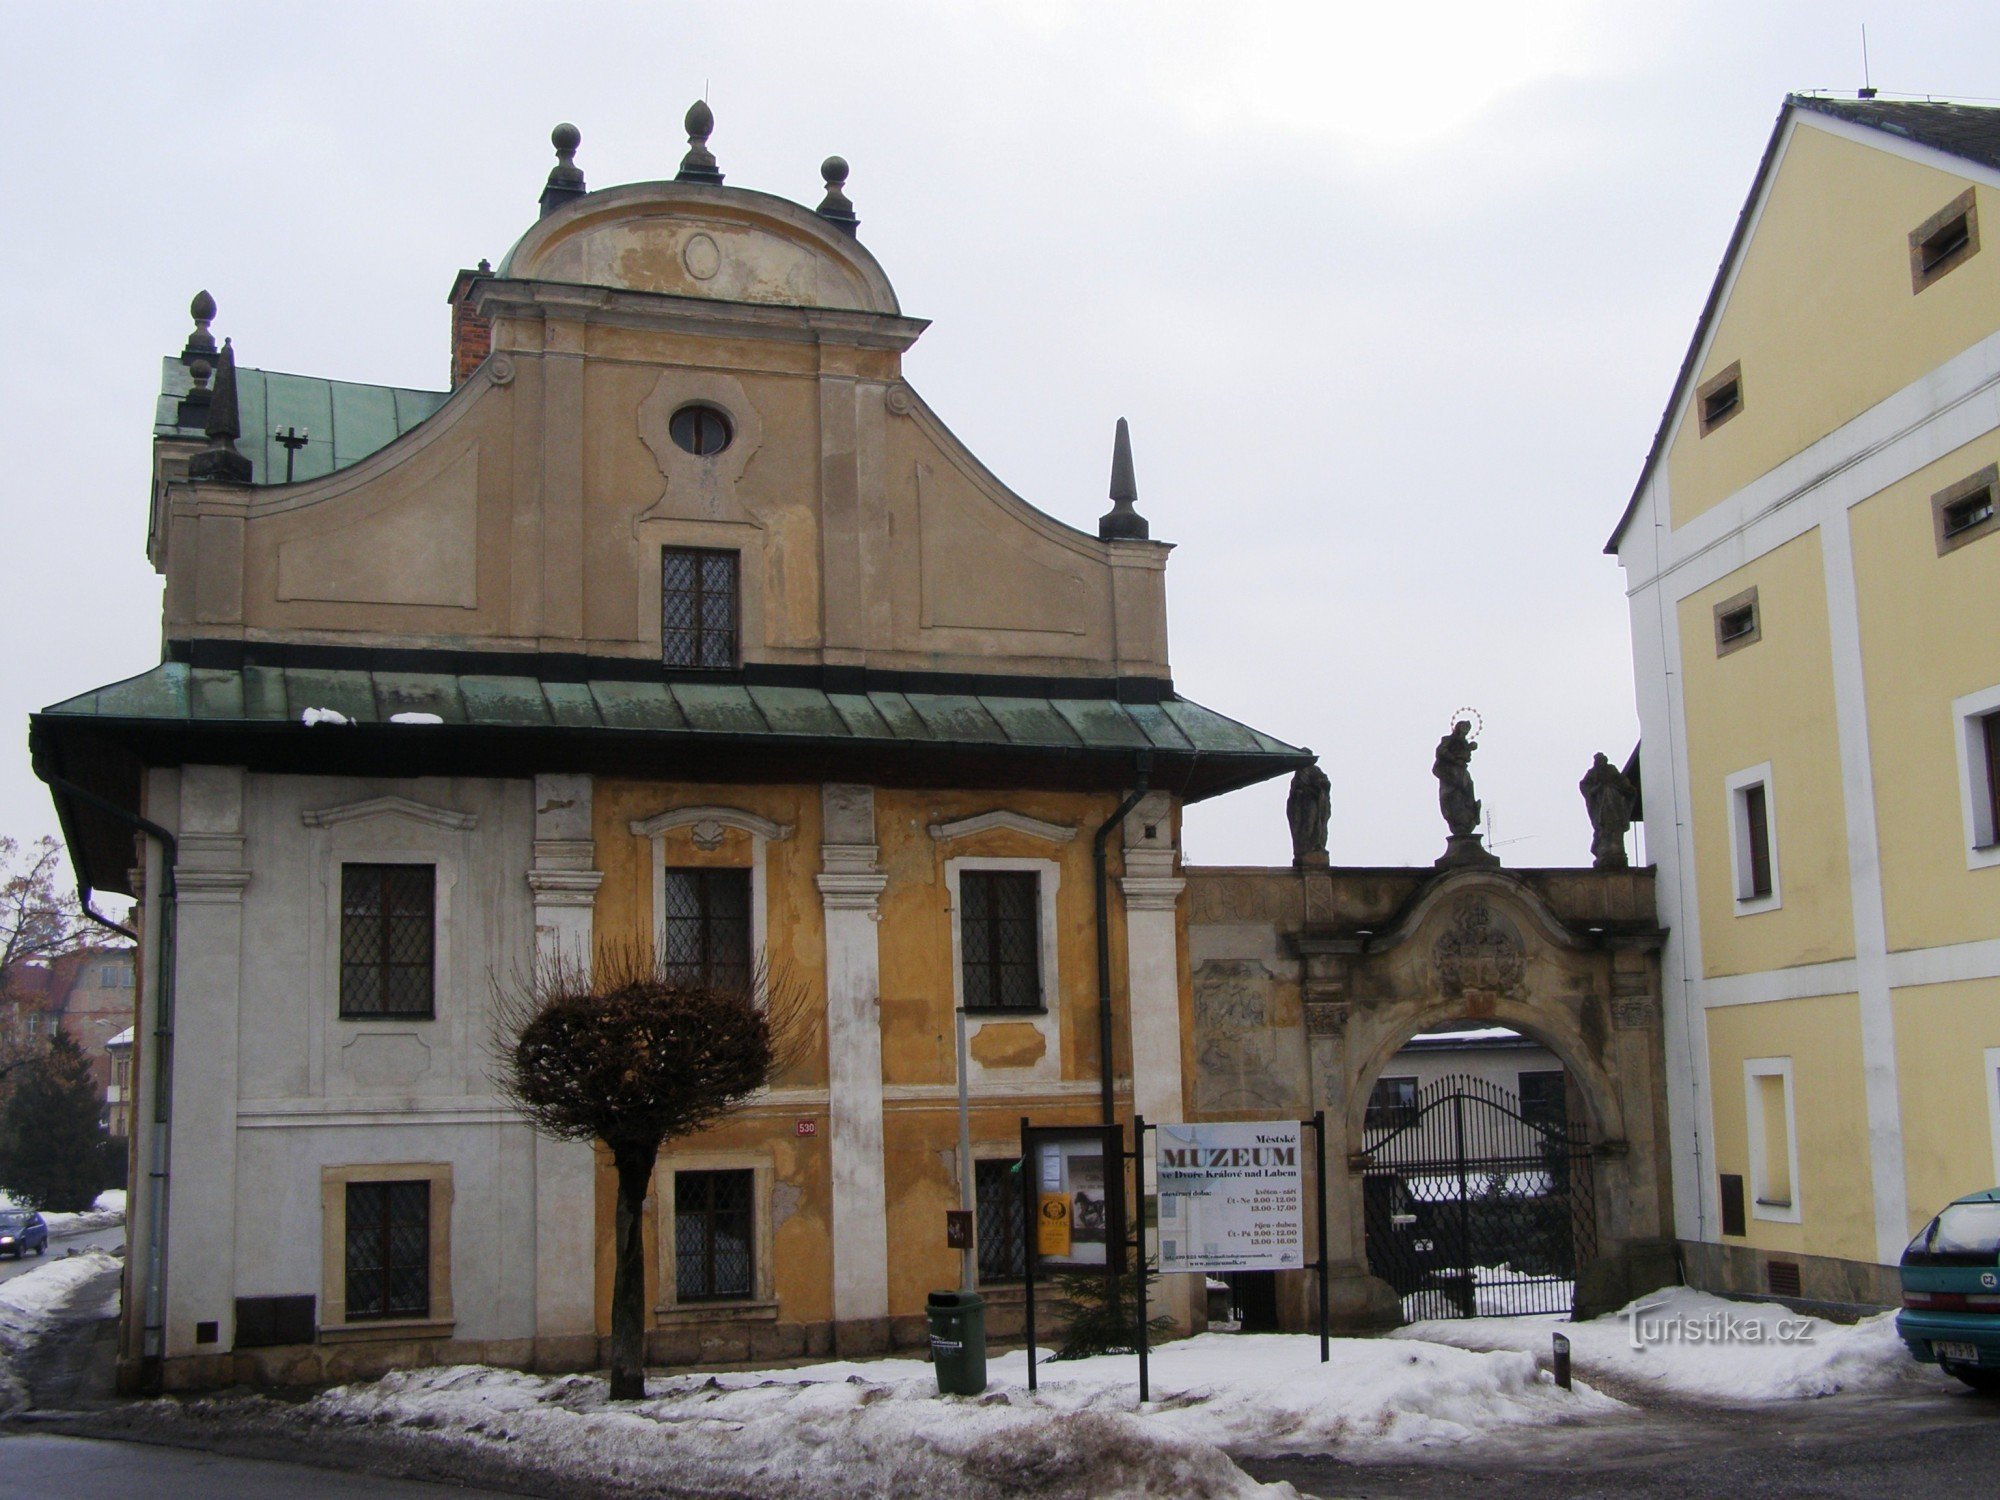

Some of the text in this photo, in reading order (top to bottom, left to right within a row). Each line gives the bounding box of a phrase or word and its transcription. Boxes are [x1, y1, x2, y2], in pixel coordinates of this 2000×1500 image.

[799, 1123, 815, 1132] 530
[1256, 1134, 1296, 1144] Městské
[1162, 1147, 1296, 1168] MUZEUM
[1174, 1170, 1204, 1179] Dvoře
[1206, 1169, 1243, 1178] Králové
[1244, 1169, 1262, 1178] nad
[1265, 1169, 1297, 1177] Labem
[1277, 1204, 1297, 1212] 17.00
[1983, 1275, 1995, 1286] CZ
